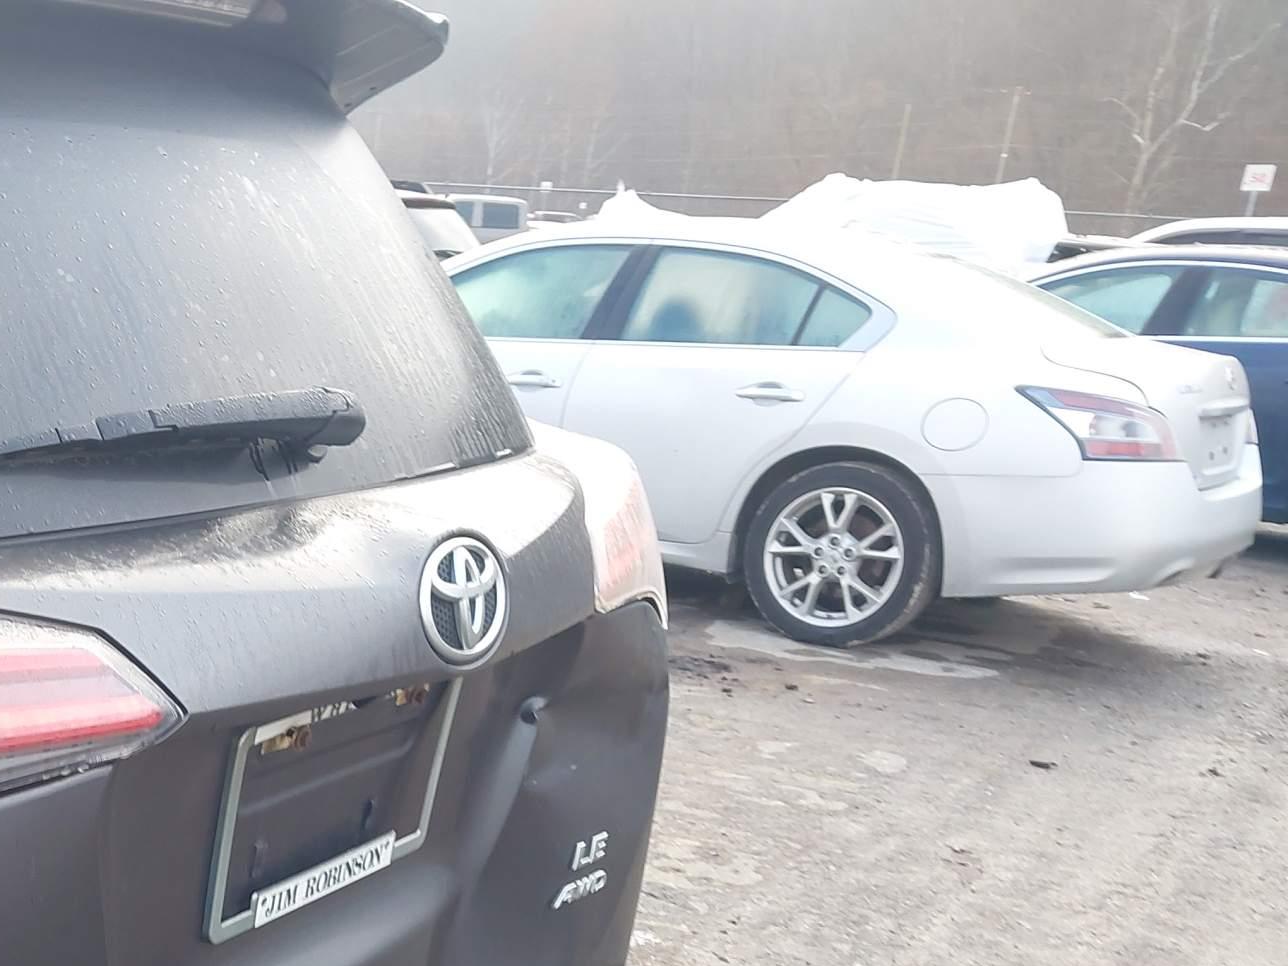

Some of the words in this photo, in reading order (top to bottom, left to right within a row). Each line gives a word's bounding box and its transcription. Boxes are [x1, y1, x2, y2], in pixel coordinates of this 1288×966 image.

[304, 844, 384, 899] ROBINSON
[571, 831, 609, 871] LE
[552, 869, 608, 910] AWD
